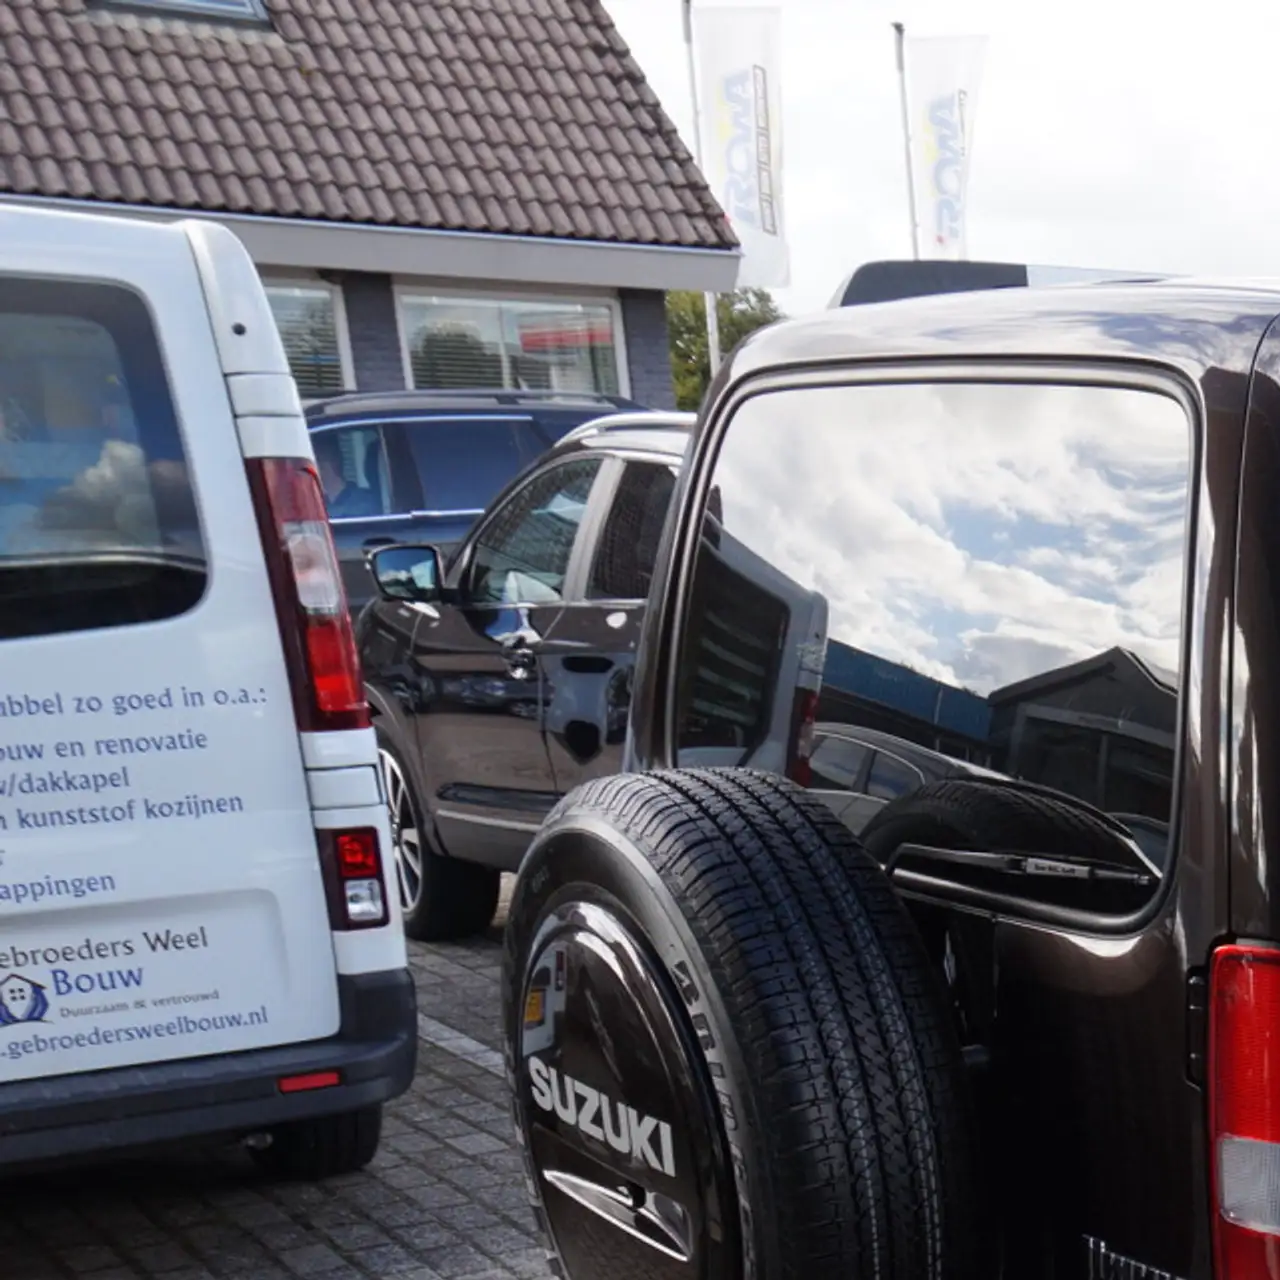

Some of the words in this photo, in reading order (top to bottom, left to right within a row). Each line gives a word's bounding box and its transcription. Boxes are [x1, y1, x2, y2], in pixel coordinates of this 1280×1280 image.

[73, 695, 103, 715] zo
[112, 688, 172, 716] goed
[181, 686, 205, 708] in
[213, 687, 268, 706] o.a.:
[54, 740, 86, 758] en
[94, 729, 209, 756] renovatie
[16, 798, 137, 829] kunststof
[143, 794, 244, 820] kozijnen
[142, 926, 209, 952] Weel
[50, 966, 145, 996] Bouw
[59, 1001, 129, 1018] Duurzaam
[528, 1055, 677, 1179] SUZUKI
